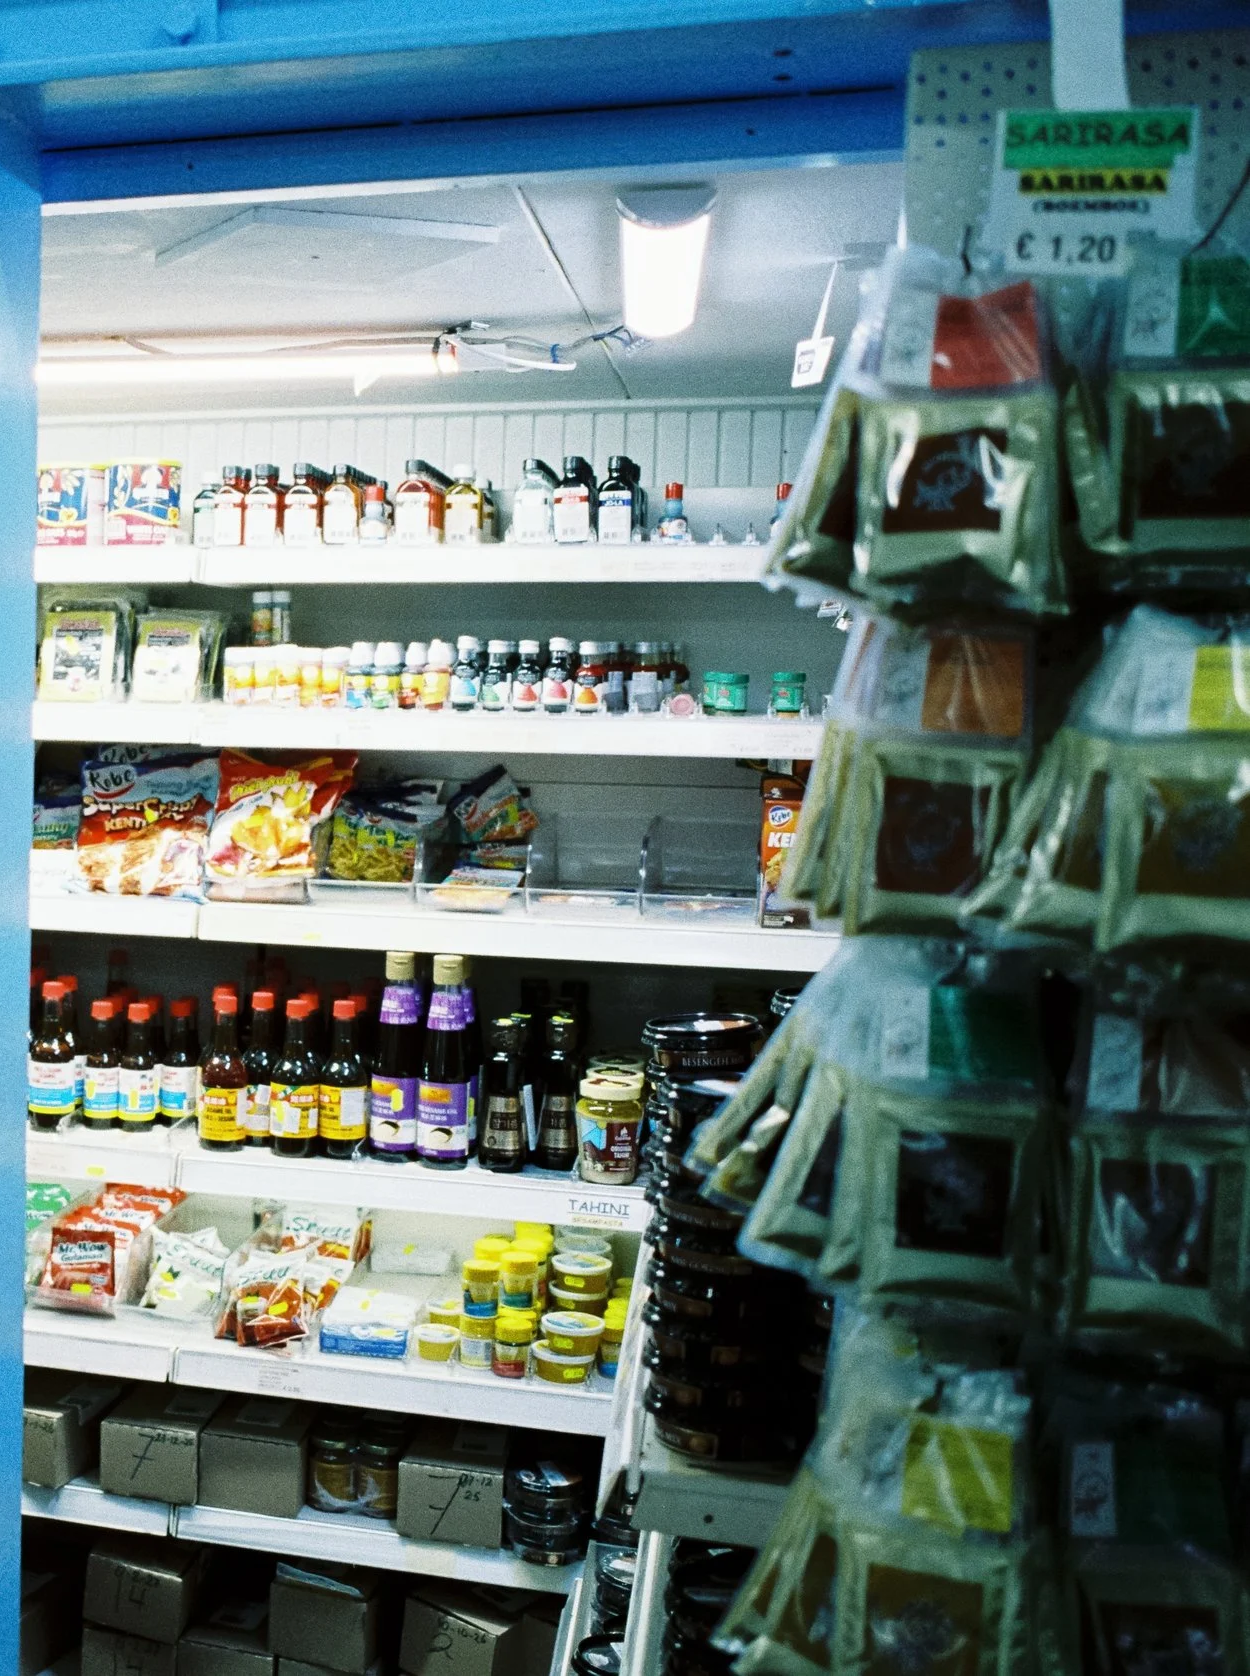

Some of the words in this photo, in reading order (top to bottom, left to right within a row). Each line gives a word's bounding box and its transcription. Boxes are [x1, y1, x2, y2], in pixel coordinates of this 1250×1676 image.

[1006, 121, 1190, 147] SARIRASA
[1051, 234, 1117, 266] 1,20
[89, 769, 132, 792] Kobe
[568, 1199, 630, 1215] TAHINI
